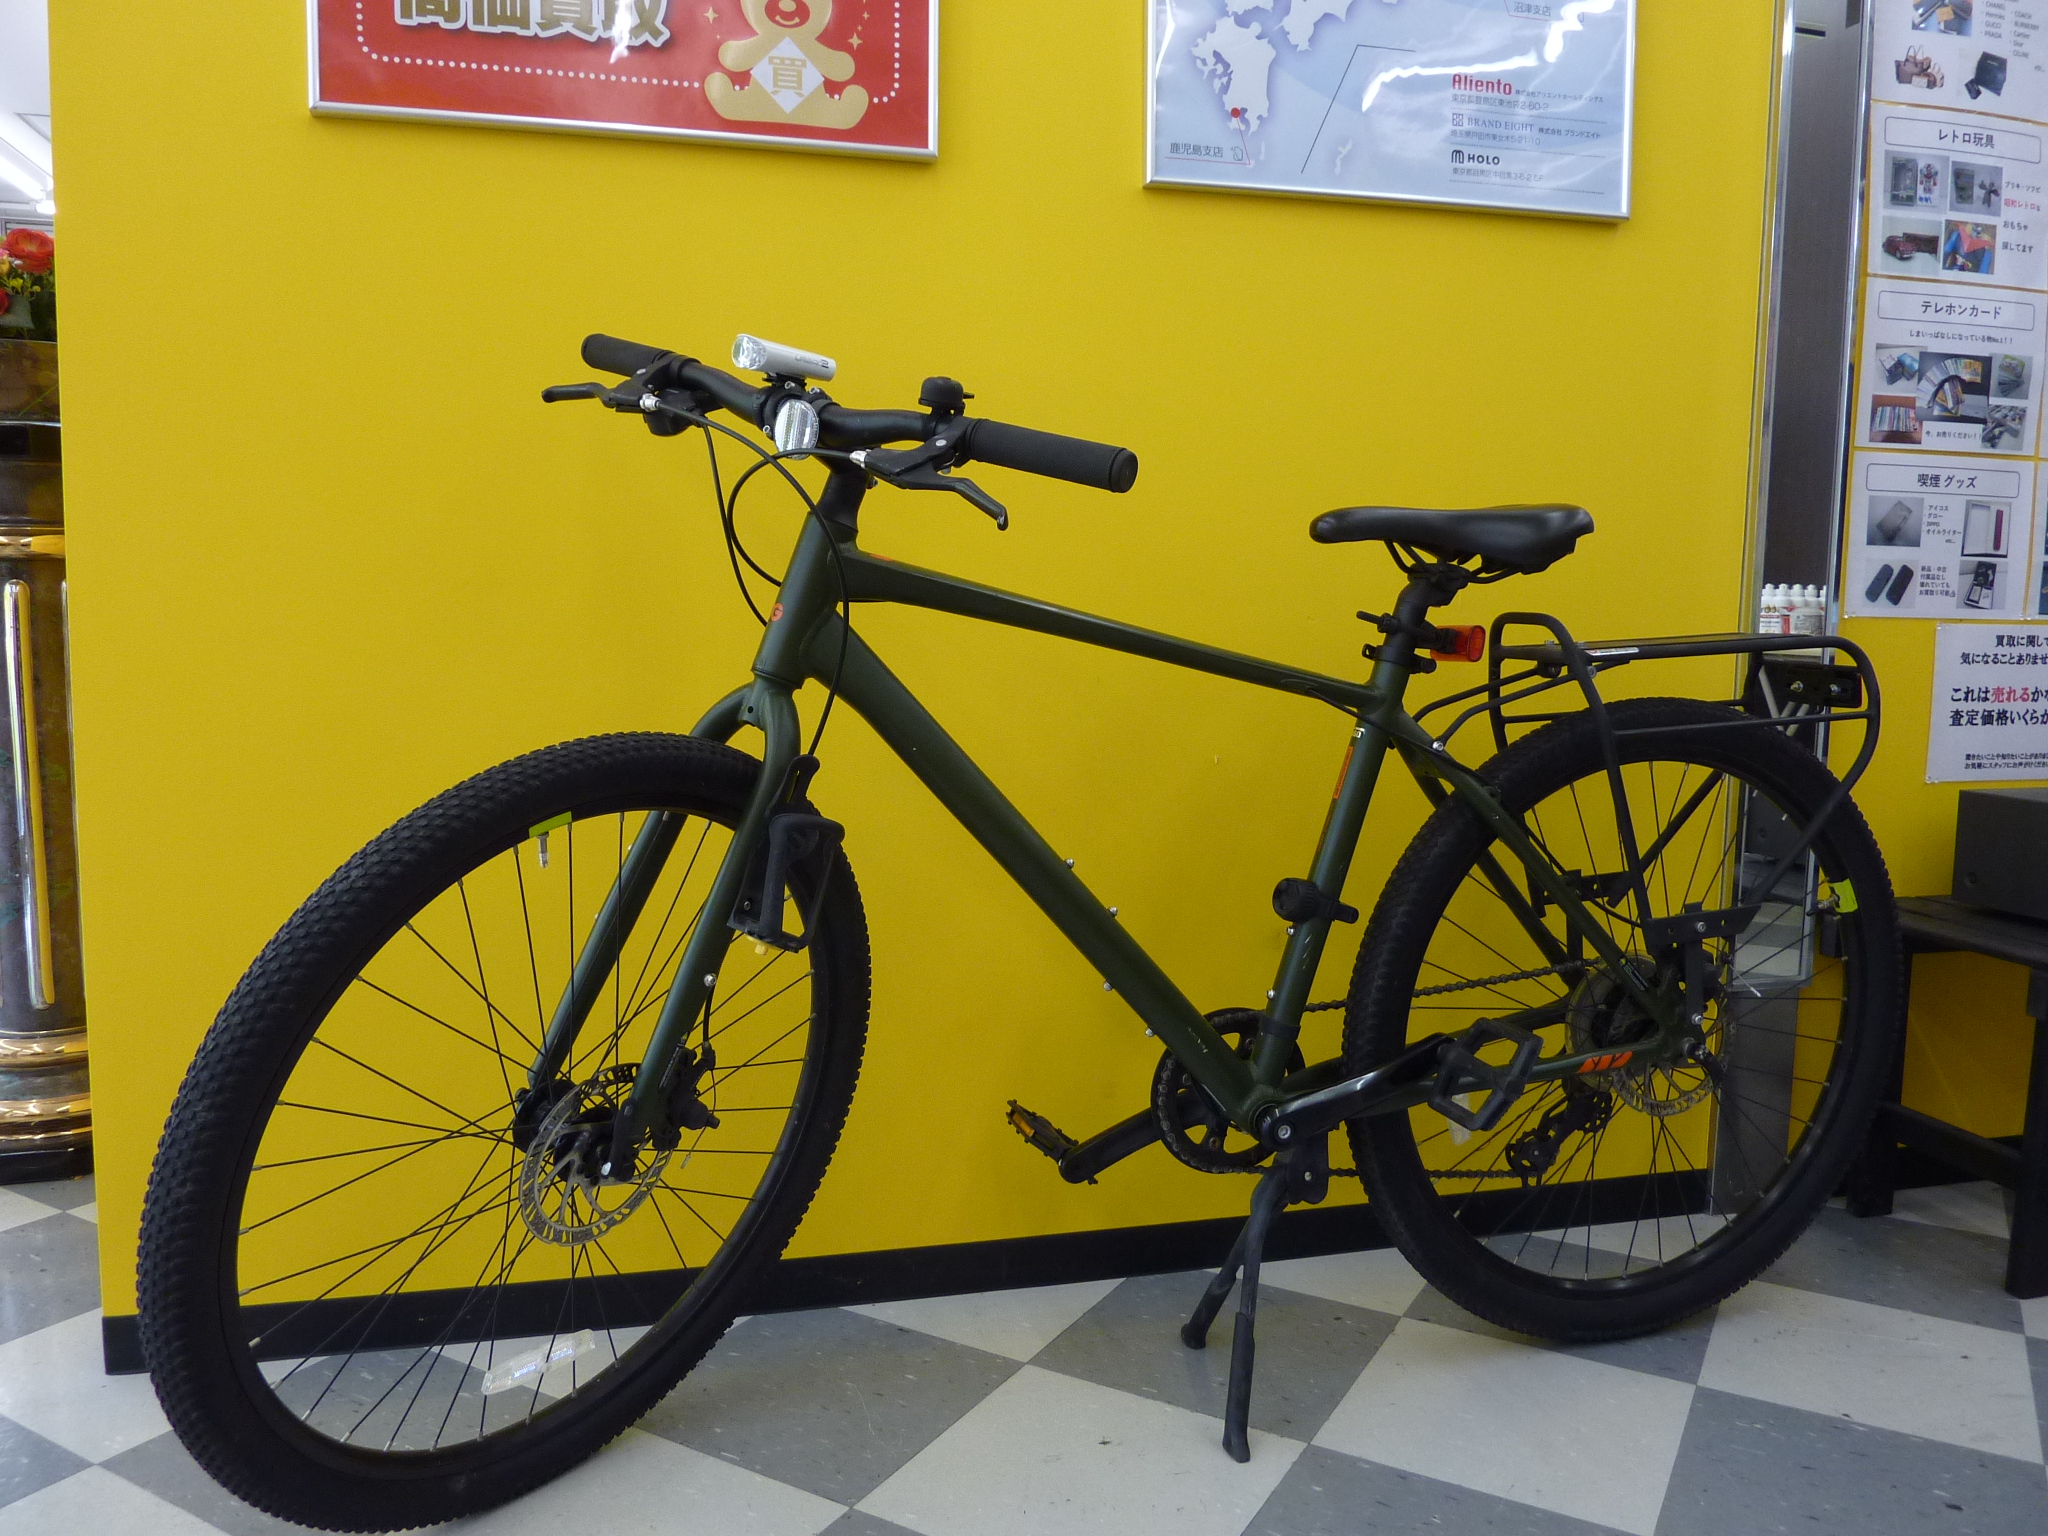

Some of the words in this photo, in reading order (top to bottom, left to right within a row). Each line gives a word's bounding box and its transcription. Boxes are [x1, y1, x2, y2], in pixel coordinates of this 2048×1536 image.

[1514, 1, 1552, 17] 沼津支店
[768, 55, 807, 98] 買
[1452, 74, 1512, 96] Aliento
[1467, 117, 1502, 129] BRAND
[1504, 121, 1535, 132] EIGHT
[1938, 128, 1995, 149] レトロ玩具
[1169, 142, 1223, 158] 鹿児島支店
[1467, 152, 1501, 166] HOLO
[1920, 300, 2002, 320] テレホンカード
[1917, 473, 1941, 488] 喫煙
[1944, 474, 1978, 489] グッズ
